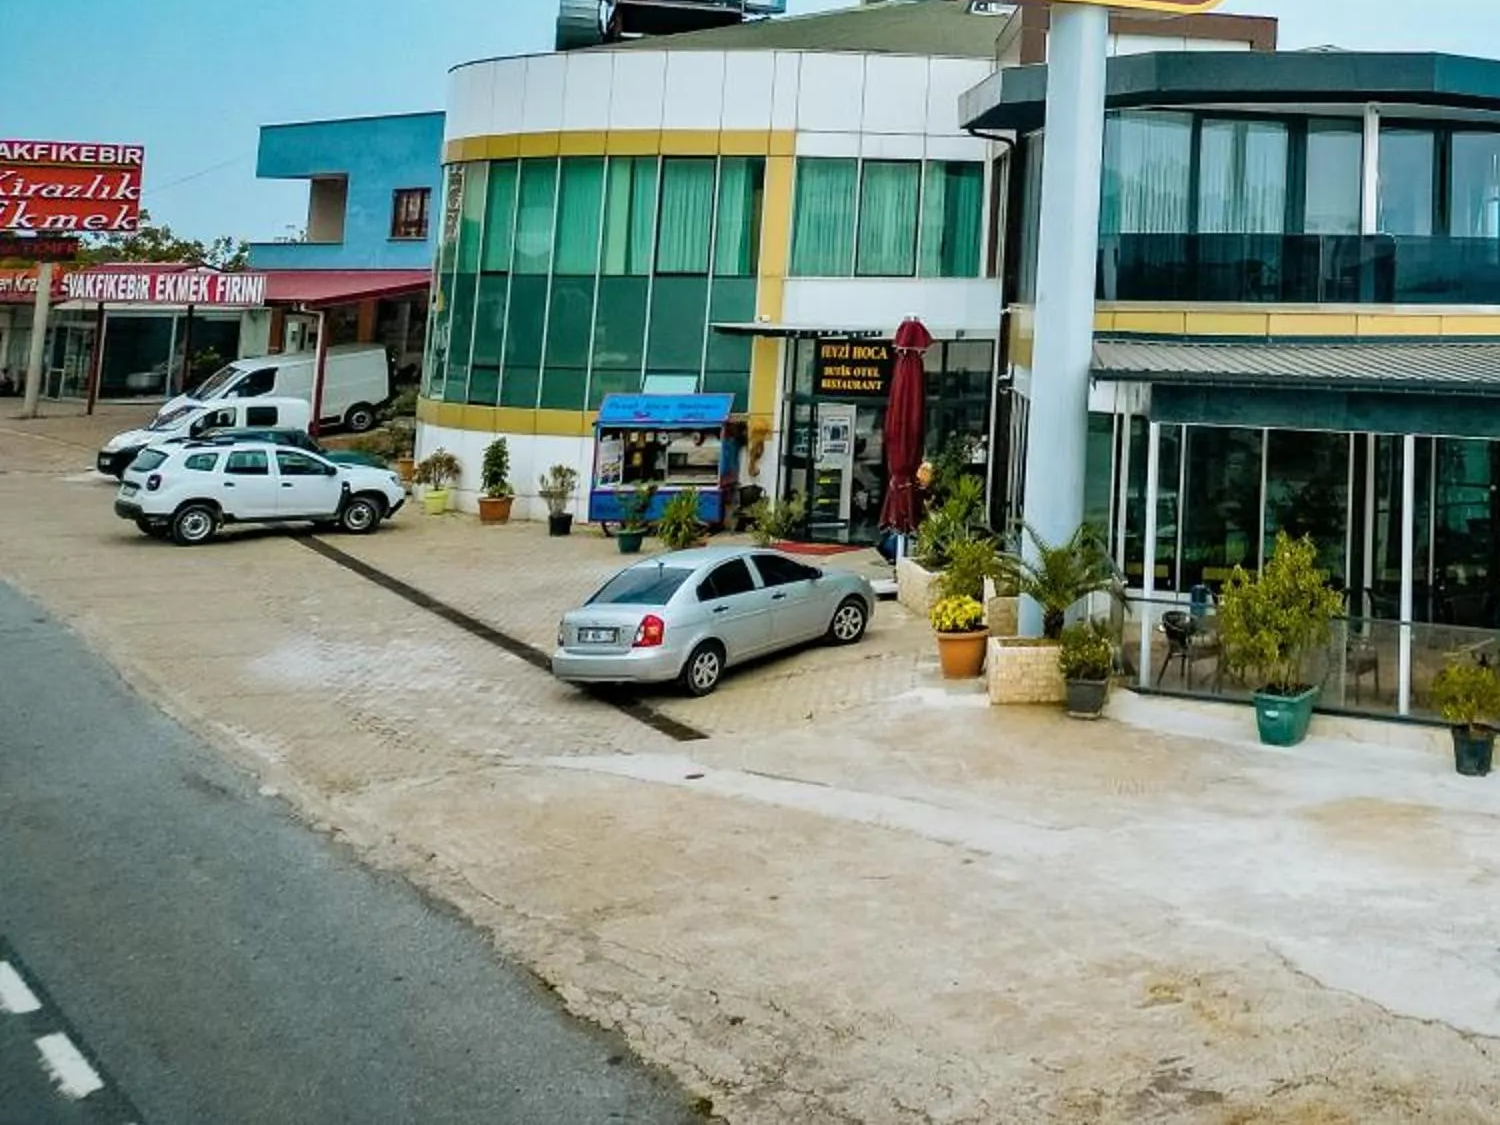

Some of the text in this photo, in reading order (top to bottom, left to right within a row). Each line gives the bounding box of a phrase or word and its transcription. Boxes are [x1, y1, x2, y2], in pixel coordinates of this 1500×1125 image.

[155, 274, 211, 302] EKMEK
[215, 275, 264, 306] FIRINI
[853, 346, 889, 360] HOCA
[853, 365, 881, 377] OTEL
